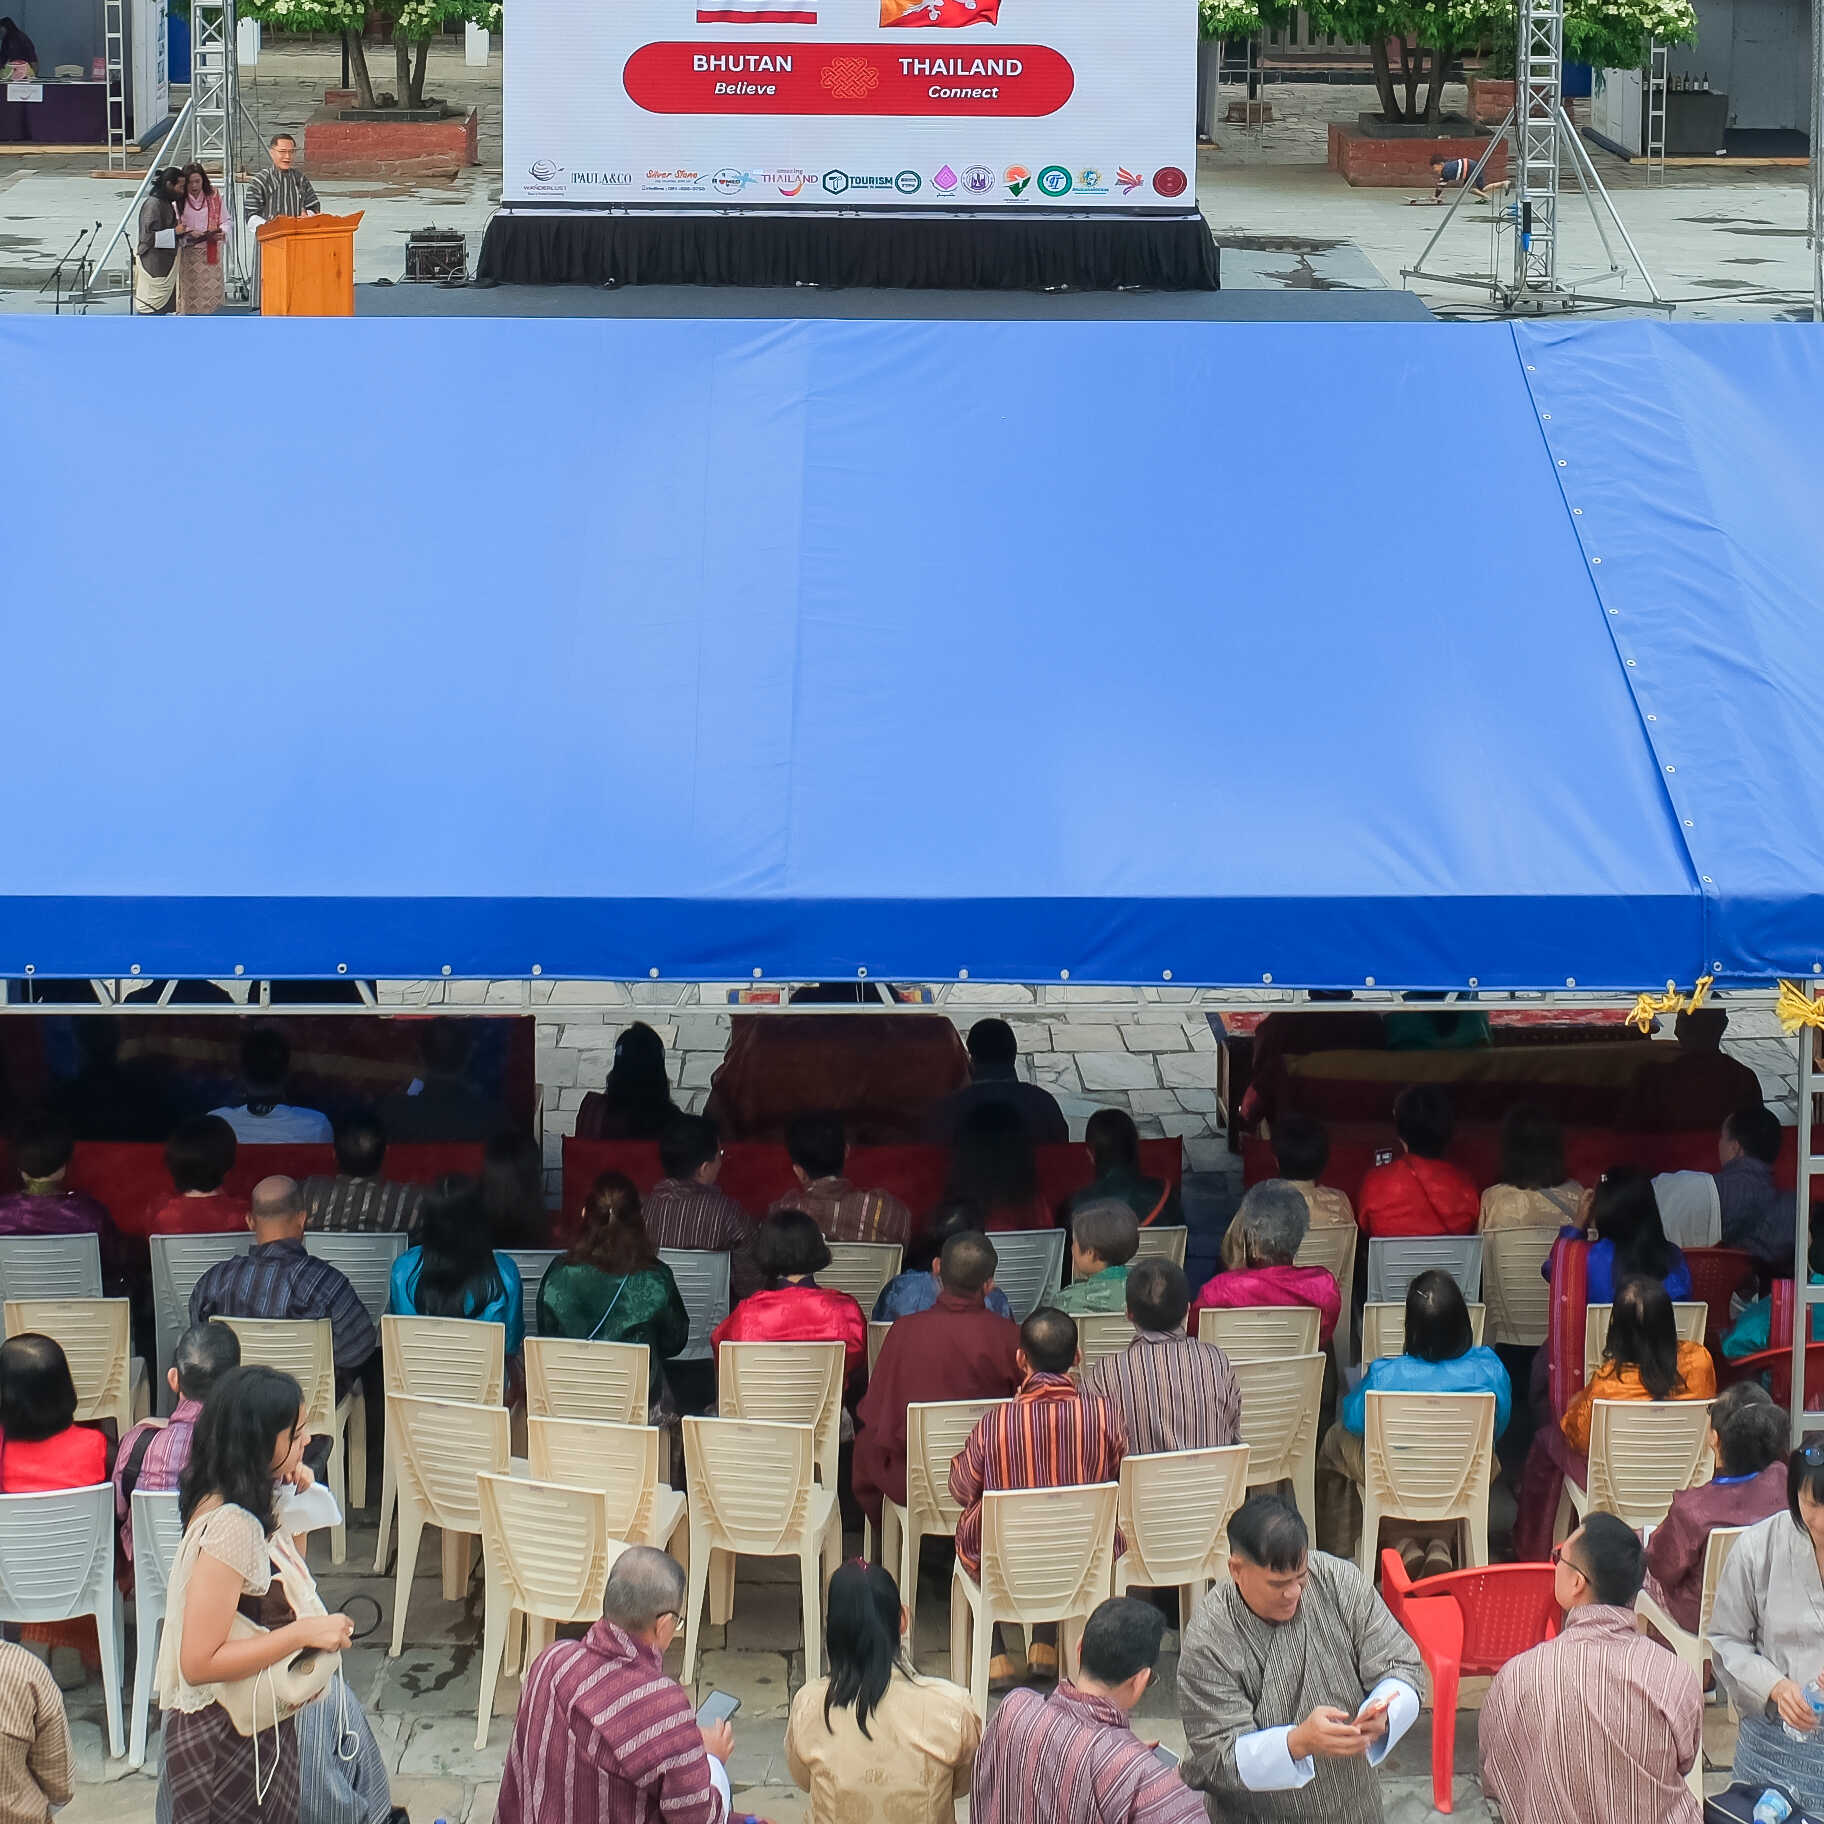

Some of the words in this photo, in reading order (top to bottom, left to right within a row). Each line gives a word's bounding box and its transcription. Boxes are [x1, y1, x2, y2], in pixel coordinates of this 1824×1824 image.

[692, 55, 793, 72] BHUTAN
[898, 58, 1023, 77] THAILAND
[714, 82, 776, 96] Believe
[928, 85, 999, 99] Connect
[762, 174, 818, 184] THAILAND
[850, 176, 893, 185] TOURISM
